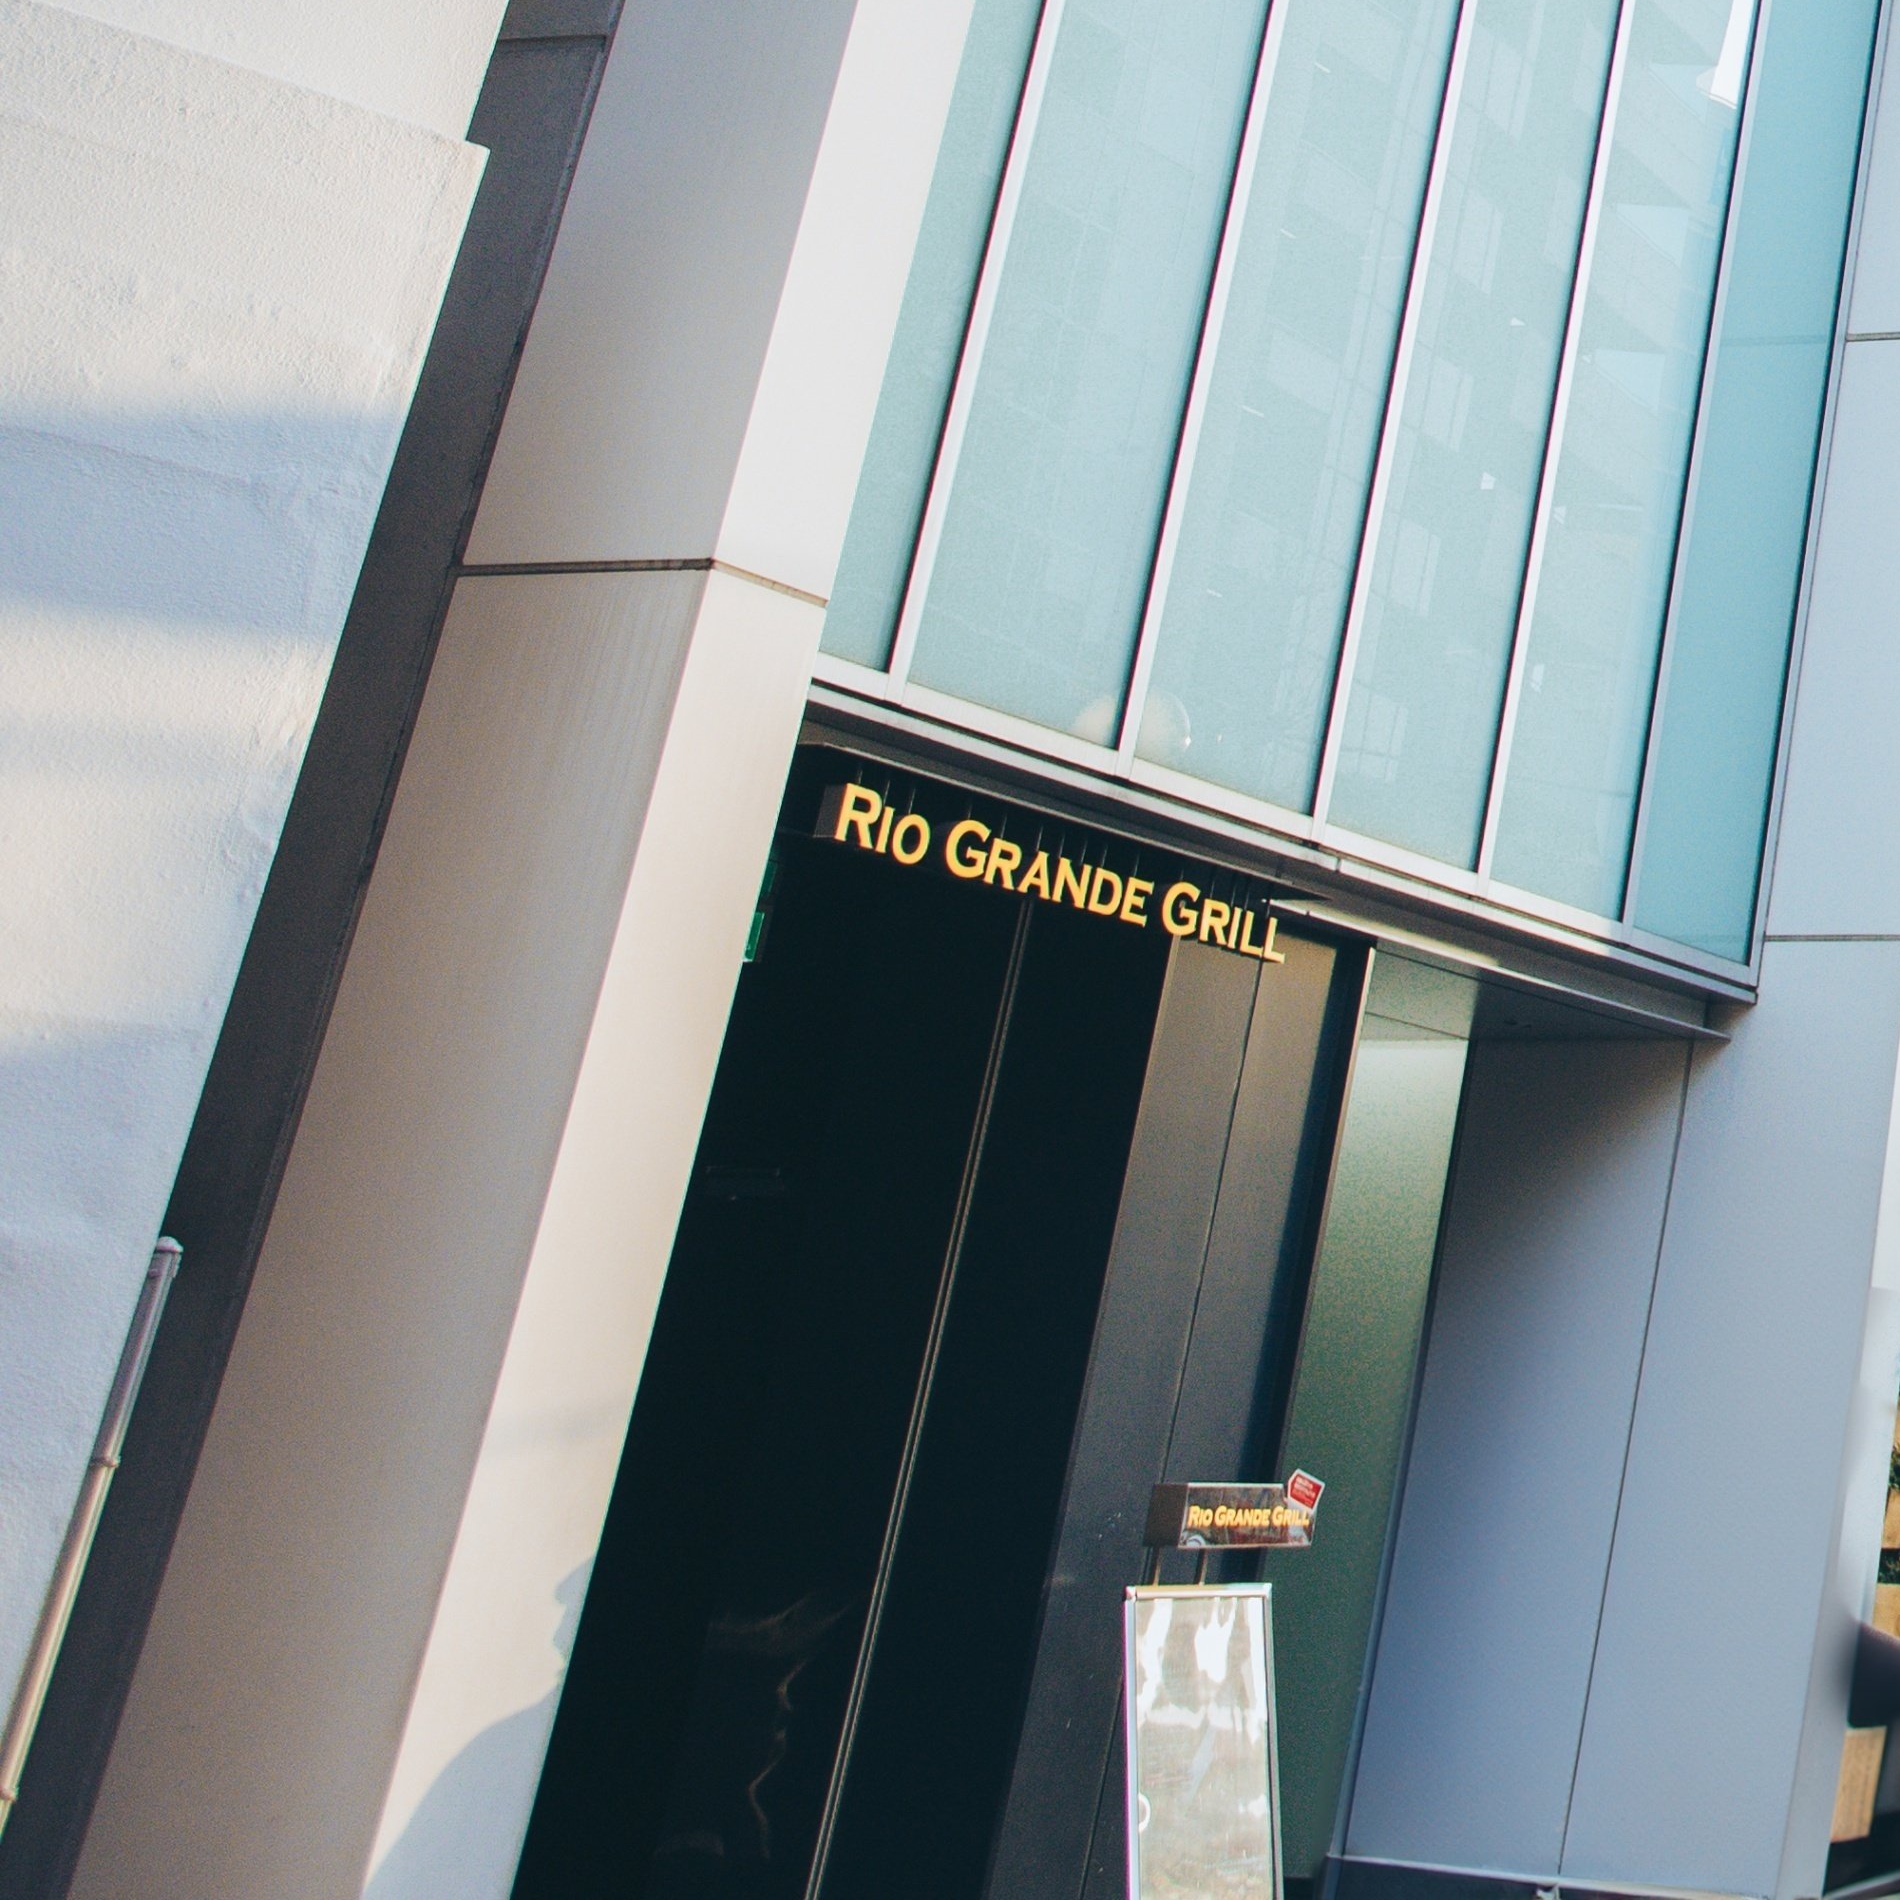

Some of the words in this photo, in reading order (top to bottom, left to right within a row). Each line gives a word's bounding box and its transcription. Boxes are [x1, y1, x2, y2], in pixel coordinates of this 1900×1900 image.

[834, 782, 931, 866] RIO
[944, 818, 1155, 929] GRANDE
[1160, 881, 1287, 965] GRILL
[1187, 1503, 1214, 1529] RIO
[1214, 1504, 1271, 1528] GRANDE
[1271, 1504, 1310, 1528] GRILL
